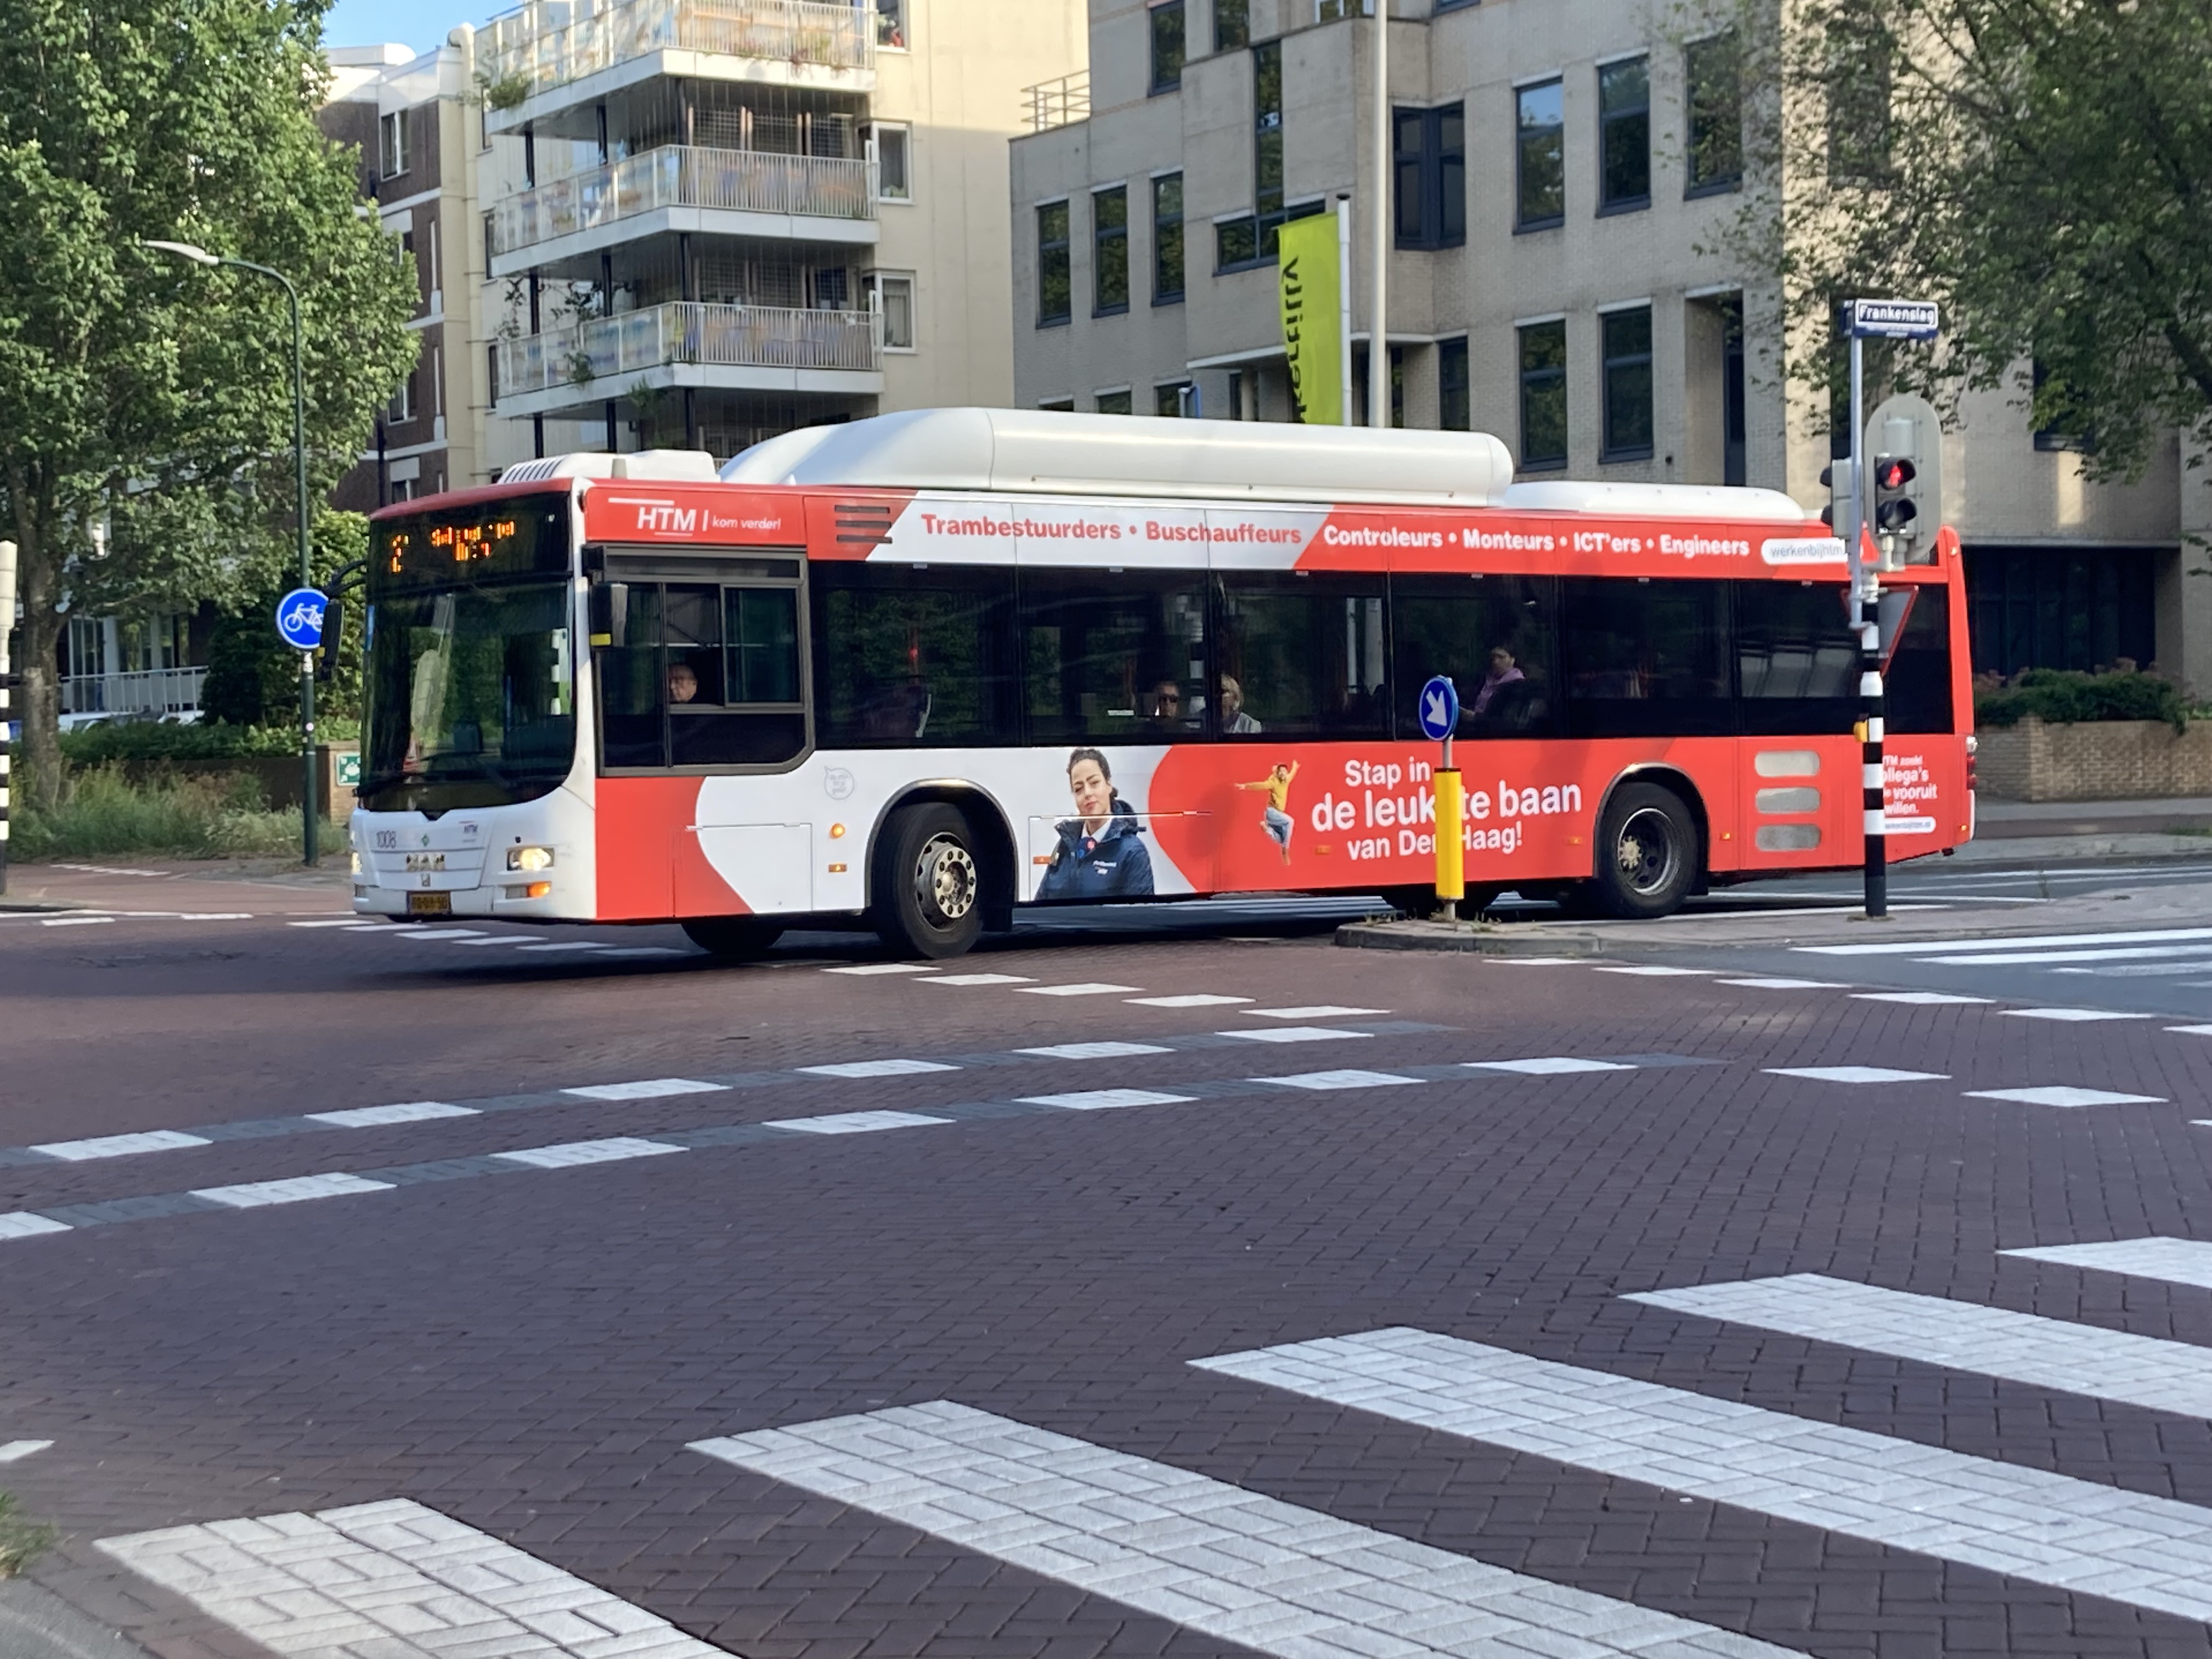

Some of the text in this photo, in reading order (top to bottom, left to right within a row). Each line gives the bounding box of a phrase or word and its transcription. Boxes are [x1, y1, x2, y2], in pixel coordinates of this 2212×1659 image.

[1859, 305, 1934, 325] Frankenslag
[637, 507, 781, 531] HTM kom verder!
[921, 514, 1750, 558] Trambestuurders Buschauffeurs Controleurs Monteurs ICT'ers Engineers
[1771, 544, 1842, 558] werkenbijhtm
[1345, 756, 1431, 790] Stap in
[1882, 768, 1929, 786] ollega's
[1893, 783, 1938, 800] vooruit
[1311, 780, 1582, 832] de leukte baan
[1347, 837, 1390, 860] van
